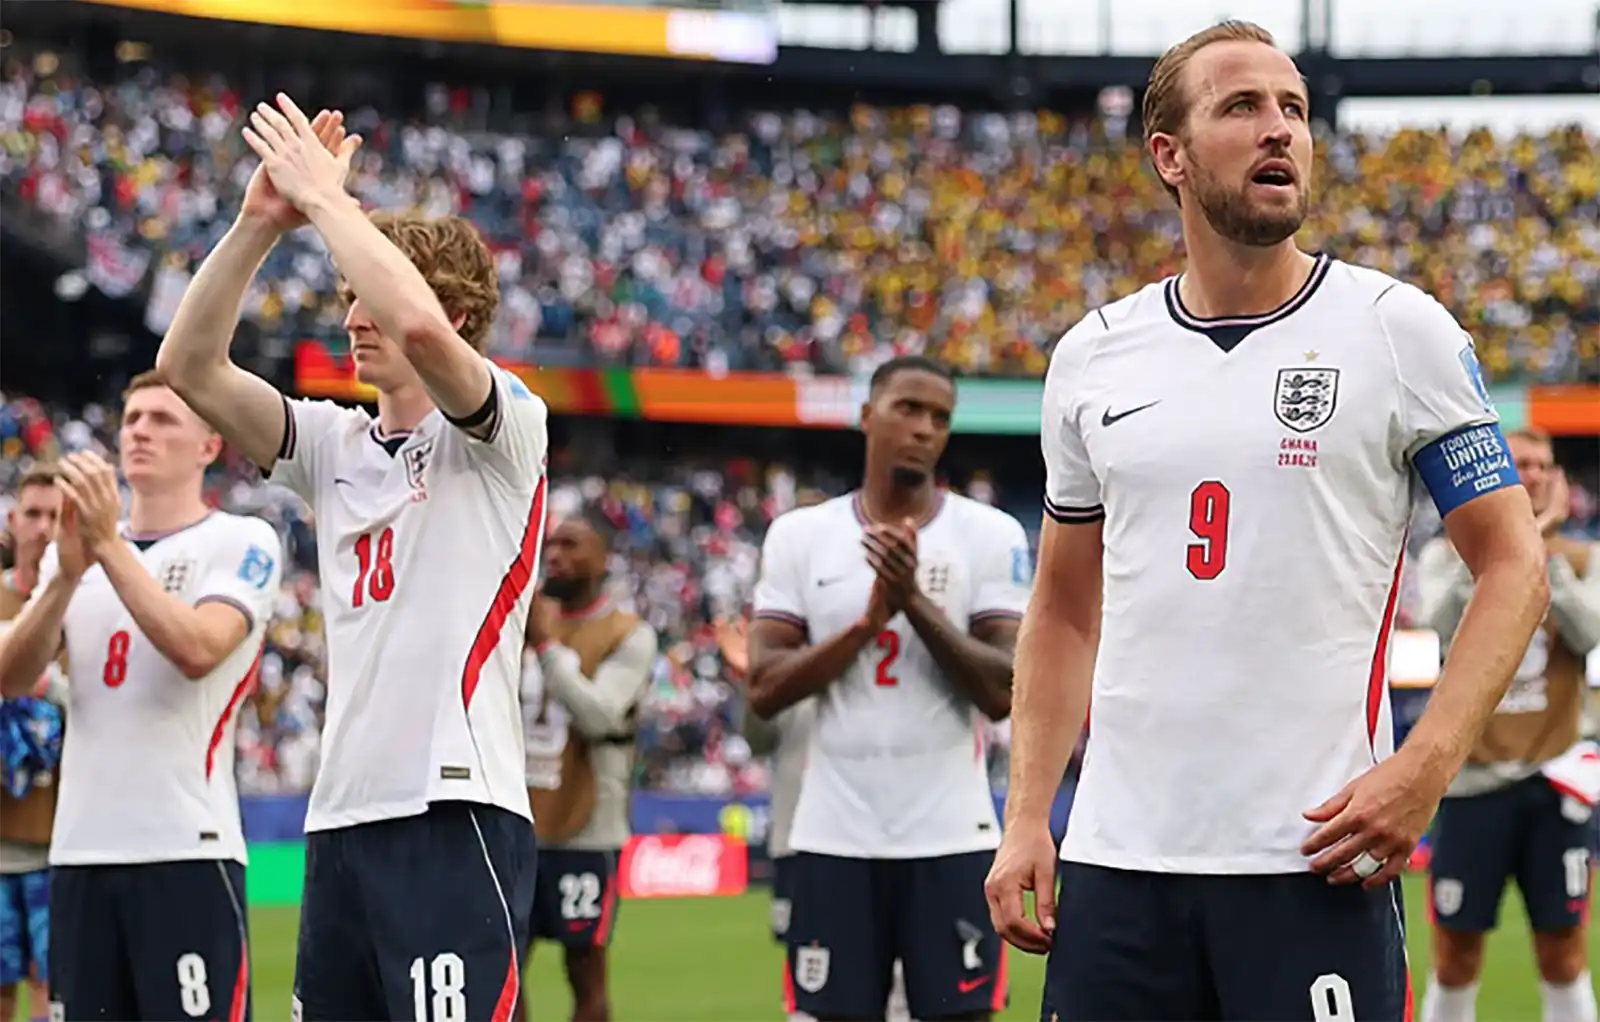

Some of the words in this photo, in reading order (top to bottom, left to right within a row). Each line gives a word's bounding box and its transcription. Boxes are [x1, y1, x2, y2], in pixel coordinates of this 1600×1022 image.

[1279, 437, 1317, 452] GHANA
[1440, 426, 1495, 454] FOOTBALL
[1444, 437, 1503, 471] UNITES
[1186, 480, 1230, 581] 9
[352, 527, 395, 609] 18
[103, 630, 130, 689] 8
[875, 629, 900, 688] 2
[558, 872, 601, 919] 22
[176, 952, 211, 1018] 8
[409, 952, 467, 1022] 18
